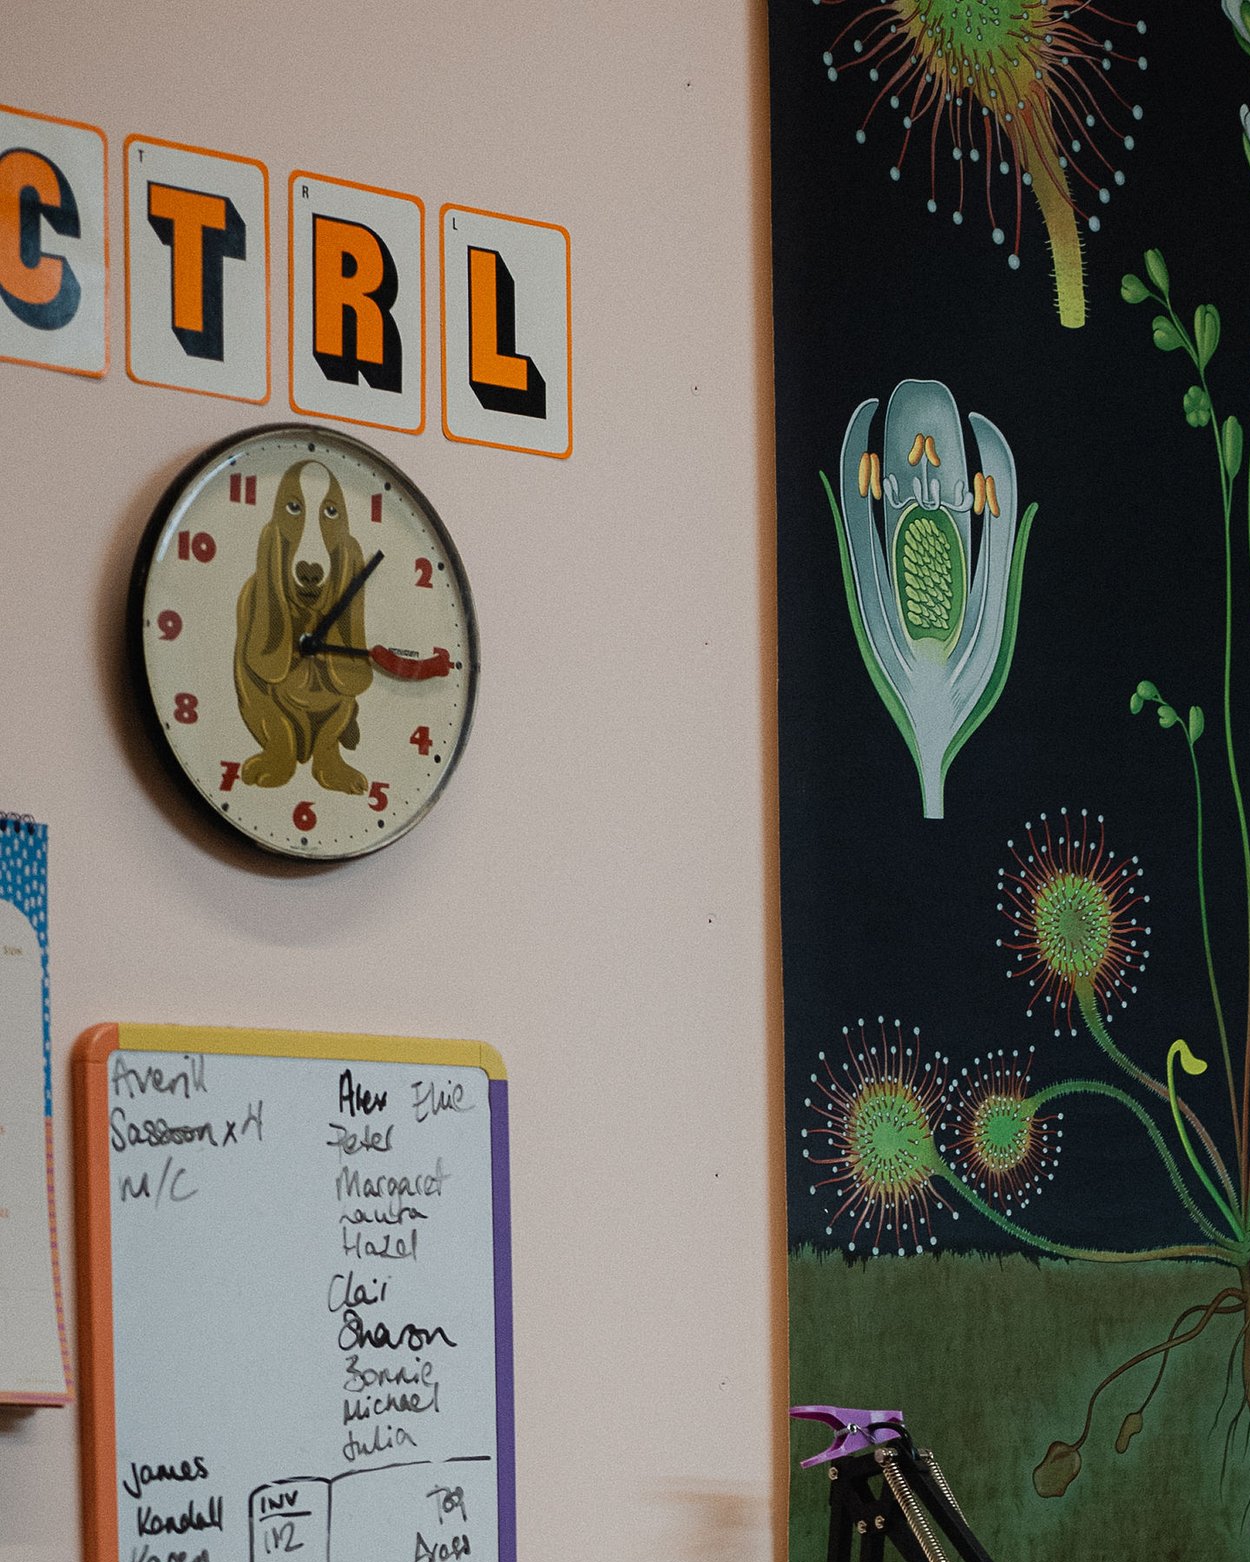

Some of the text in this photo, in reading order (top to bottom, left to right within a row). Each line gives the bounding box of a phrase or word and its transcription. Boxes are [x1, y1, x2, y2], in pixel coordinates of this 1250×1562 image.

[138, 150, 145, 163] T
[302, 185, 310, 199] R
[452, 217, 459, 231] L
[229, 472, 257, 505] 11
[371, 493, 383, 523] 1
[177, 530, 217, 563] 10
[414, 557, 433, 589] 2
[157, 609, 183, 641] 9
[173, 692, 199, 724] 8
[409, 725, 433, 756] 4
[219, 760, 241, 792] 7
[367, 781, 390, 812] 5
[292, 801, 317, 831] 6
[122, 1455, 209, 1500] James
